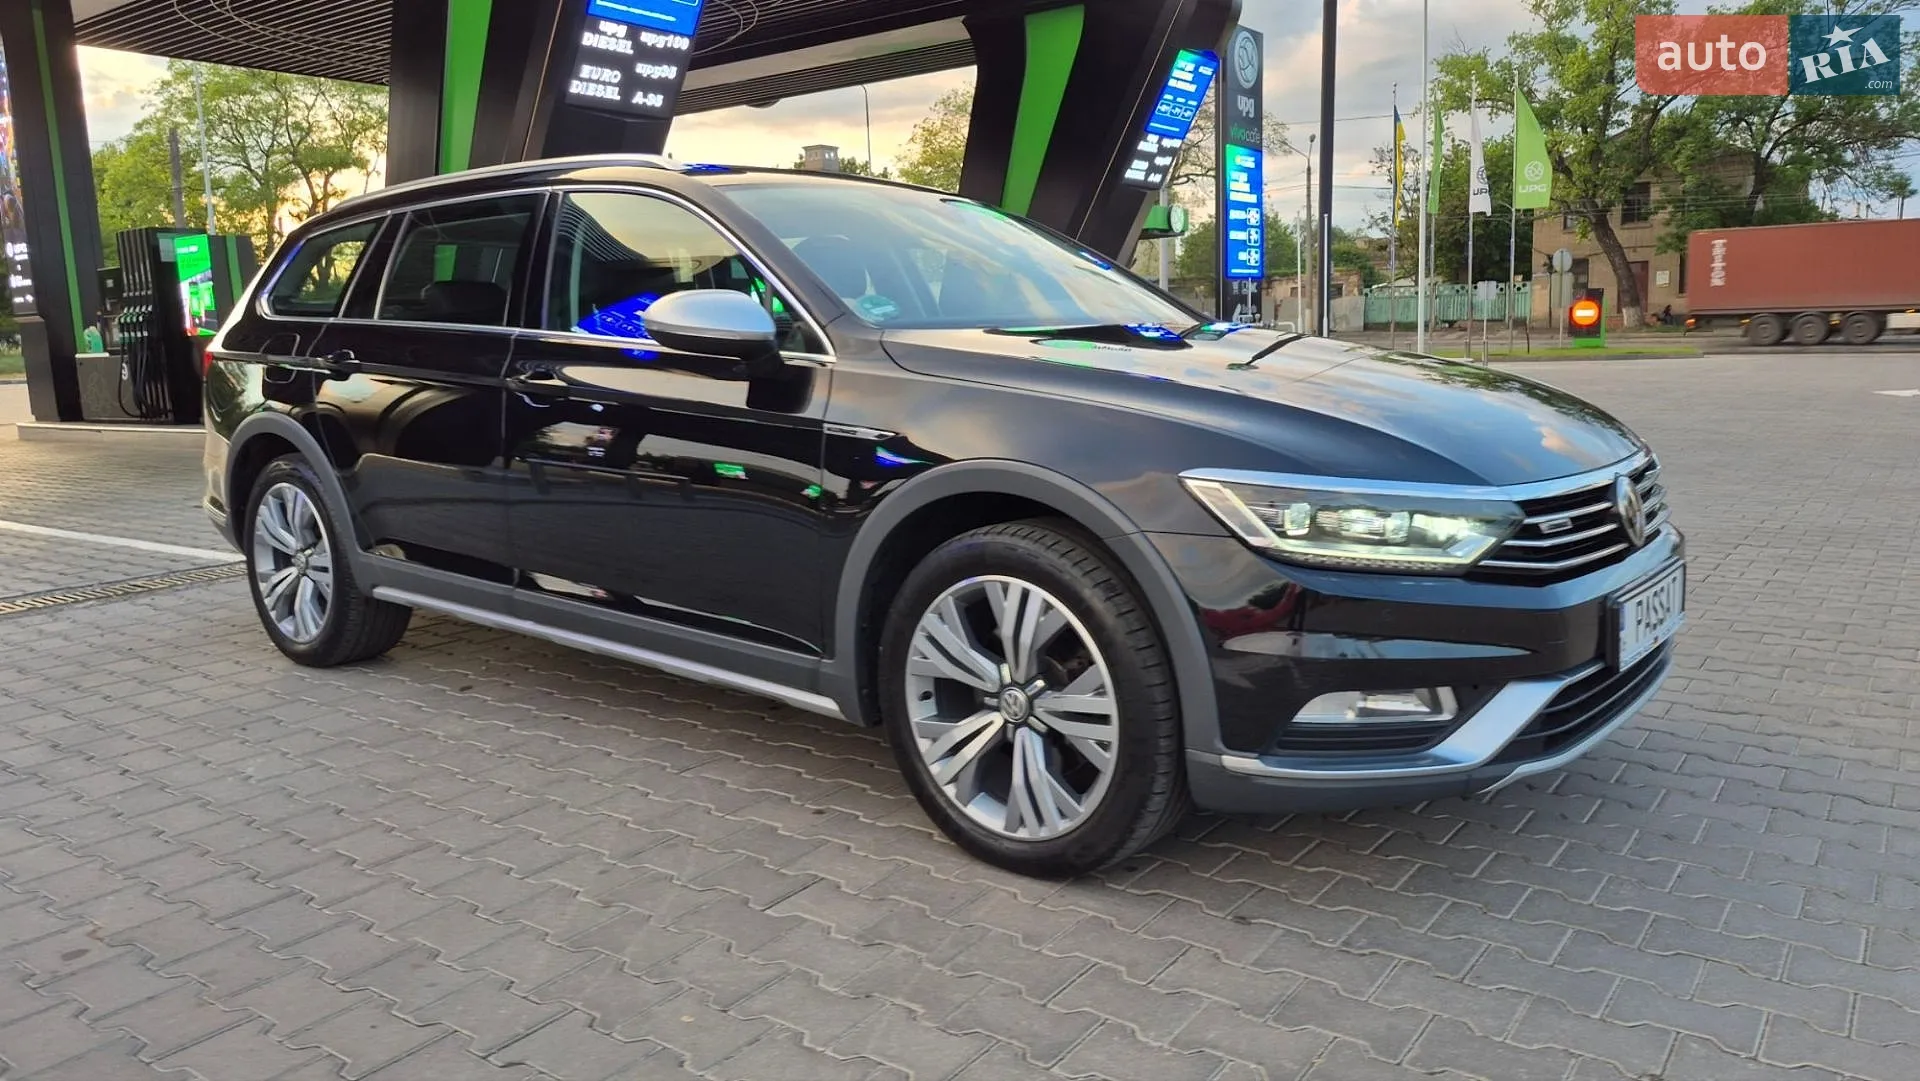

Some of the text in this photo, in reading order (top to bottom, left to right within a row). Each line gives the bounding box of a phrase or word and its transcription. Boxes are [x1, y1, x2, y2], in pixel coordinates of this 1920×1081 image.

[581, 32, 634, 54] DIESEL
[579, 64, 621, 83] EURO
[569, 80, 621, 100] DIESEL
[1237, 95, 1255, 118] upg
